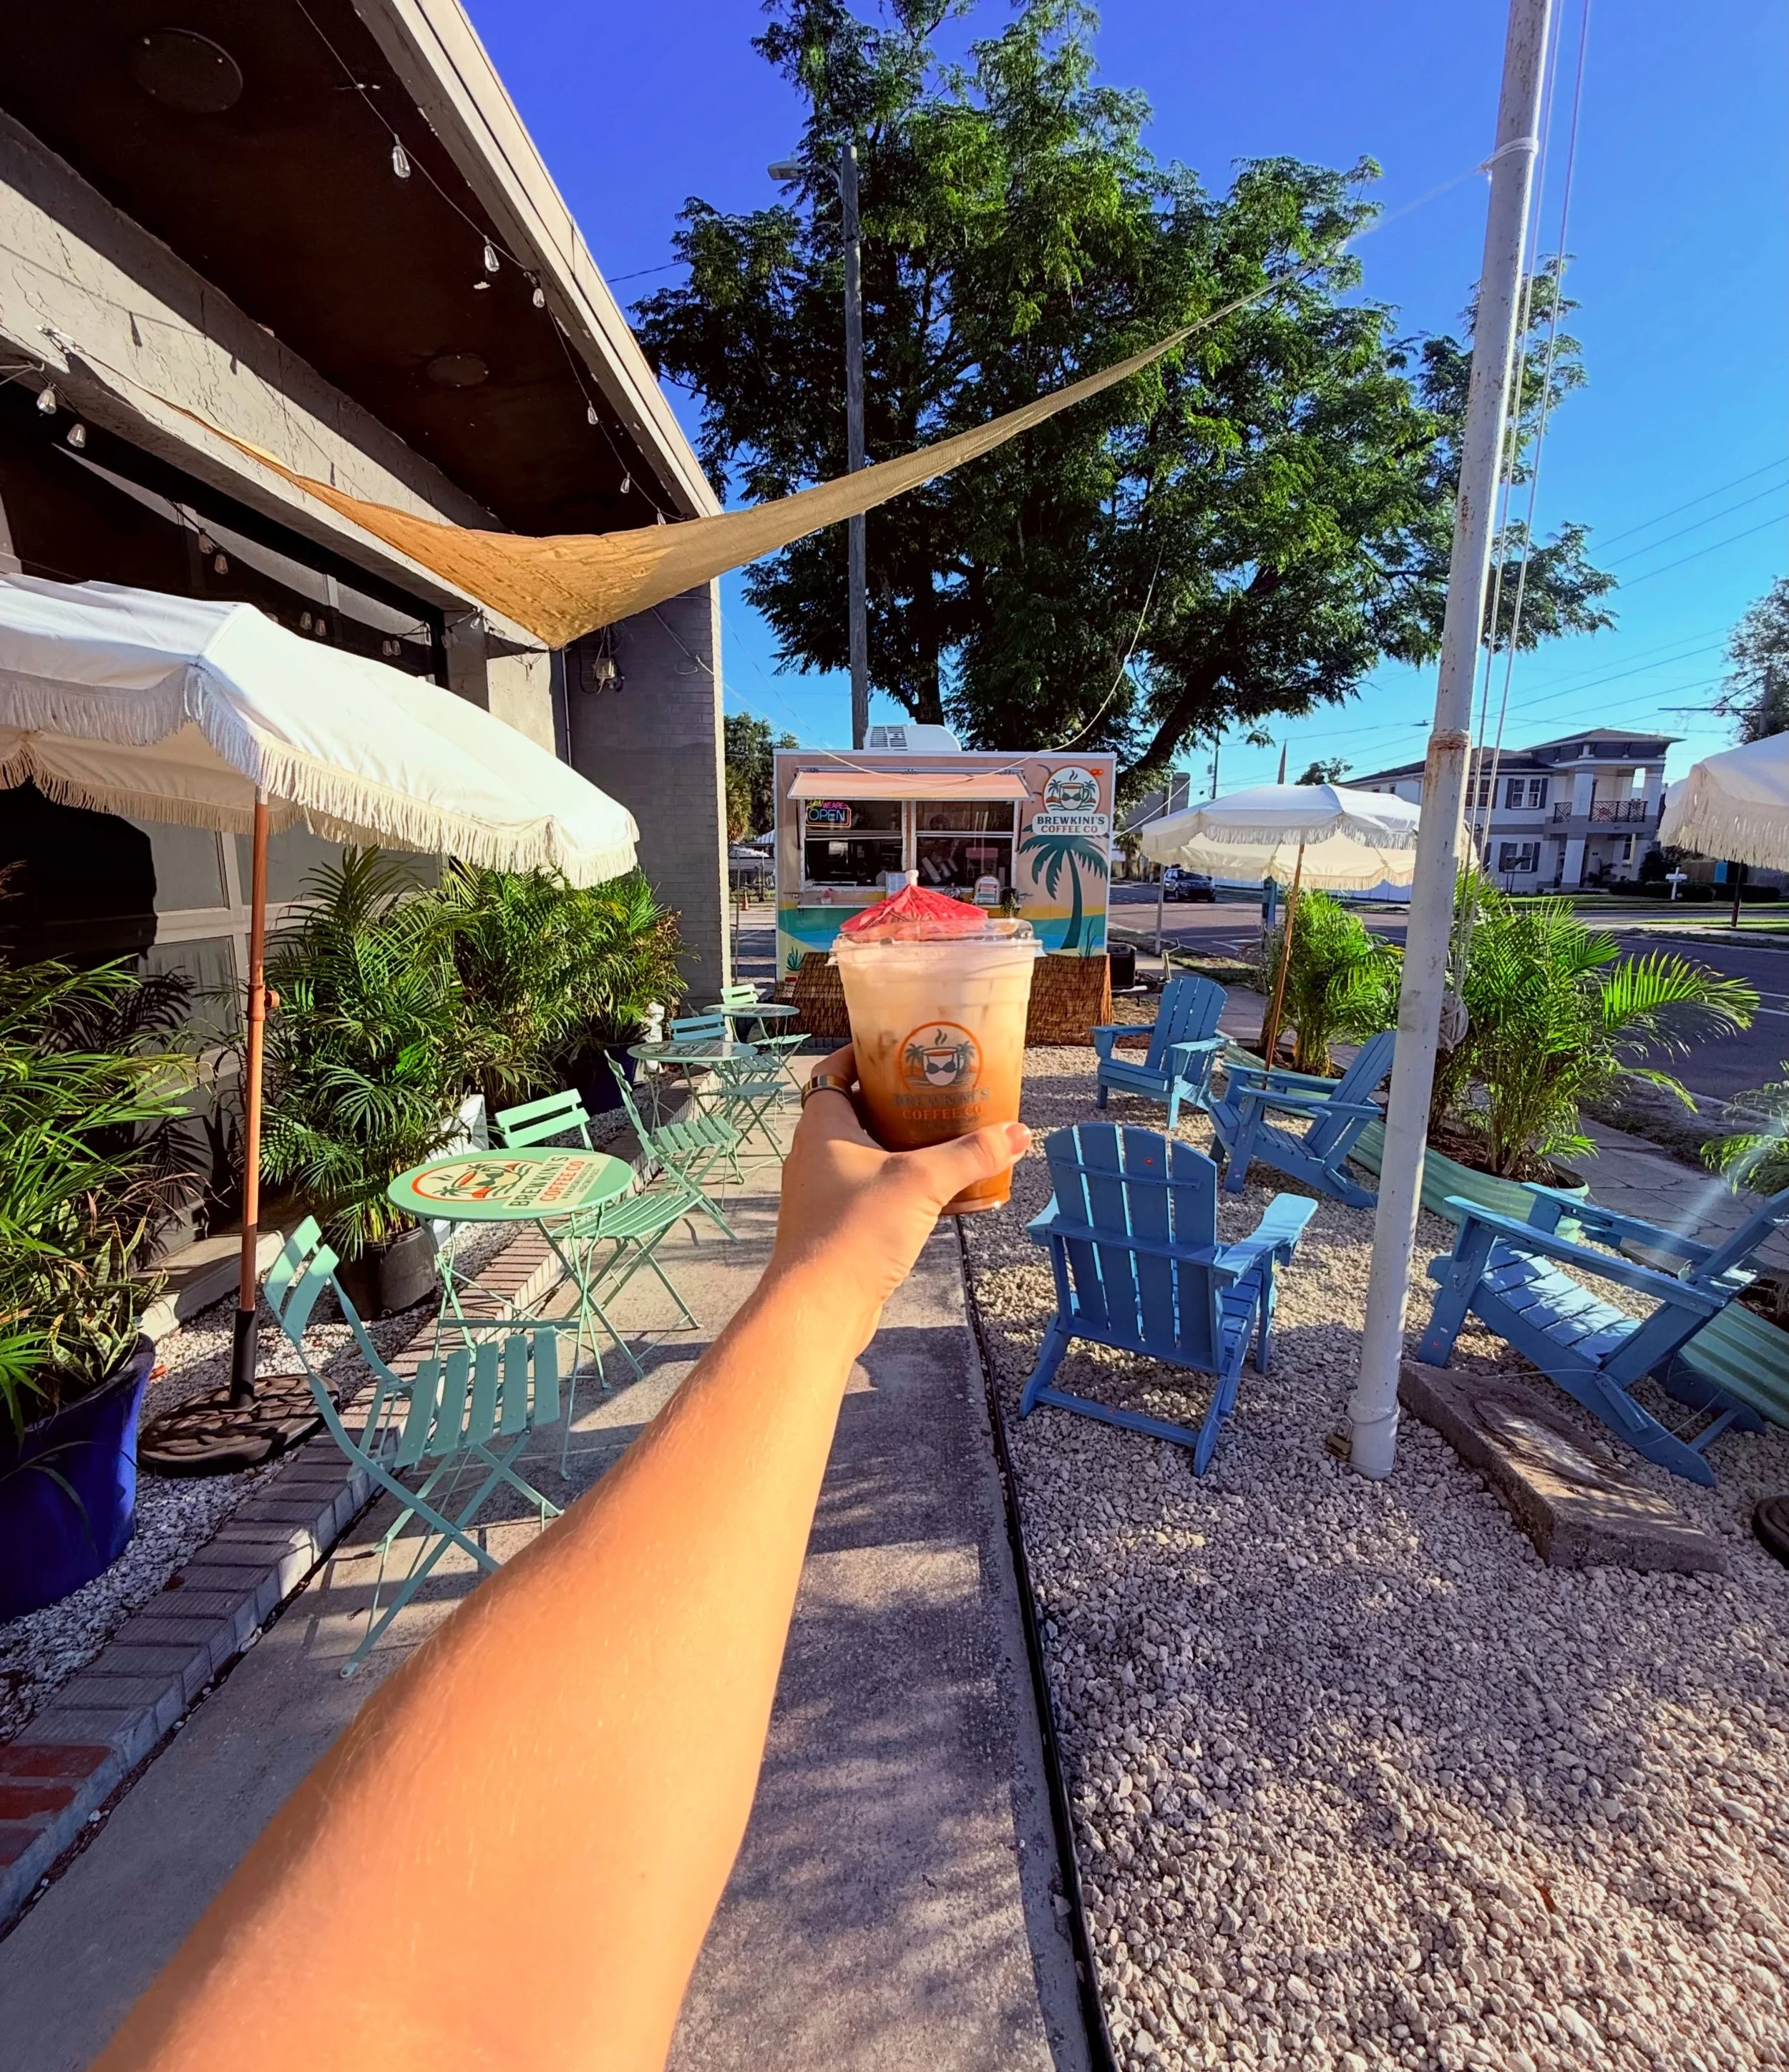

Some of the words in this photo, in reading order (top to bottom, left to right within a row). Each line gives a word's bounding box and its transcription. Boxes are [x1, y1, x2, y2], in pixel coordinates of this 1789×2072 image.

[809, 808, 845, 821] OPEN
[1037, 816, 1105, 825] BREWKINI'S
[1083, 825, 1098, 834] CO
[902, 1108, 960, 1120] COFFEE
[965, 1104, 983, 1116] CO
[508, 1156, 569, 1206] BREWKINI'S
[539, 1172, 577, 1202] COFFEE
[565, 1160, 585, 1171] CO
